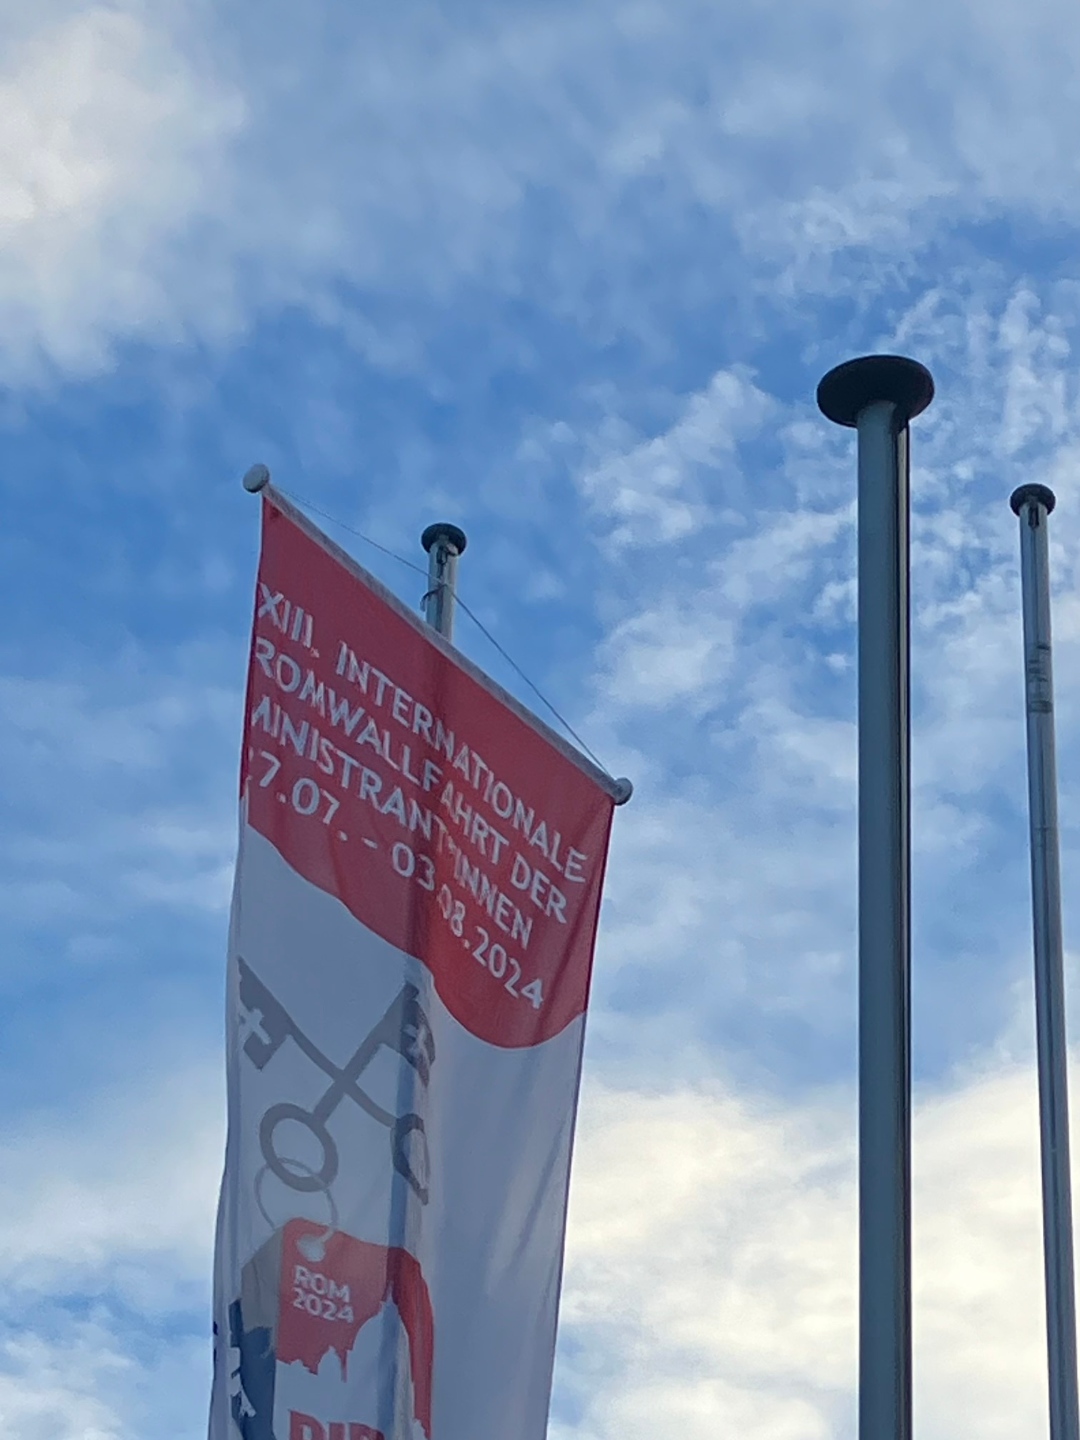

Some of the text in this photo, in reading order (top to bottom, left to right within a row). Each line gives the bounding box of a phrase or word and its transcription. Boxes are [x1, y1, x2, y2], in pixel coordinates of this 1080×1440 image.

[258, 582, 587, 883] XIII. INTERNATIONALE
[248, 747, 347, 841] 7.07.
[255, 636, 567, 924] ROMWALLFAHRT DER
[293, 1286, 354, 1324] 2024
[294, 1265, 350, 1303] ROM
